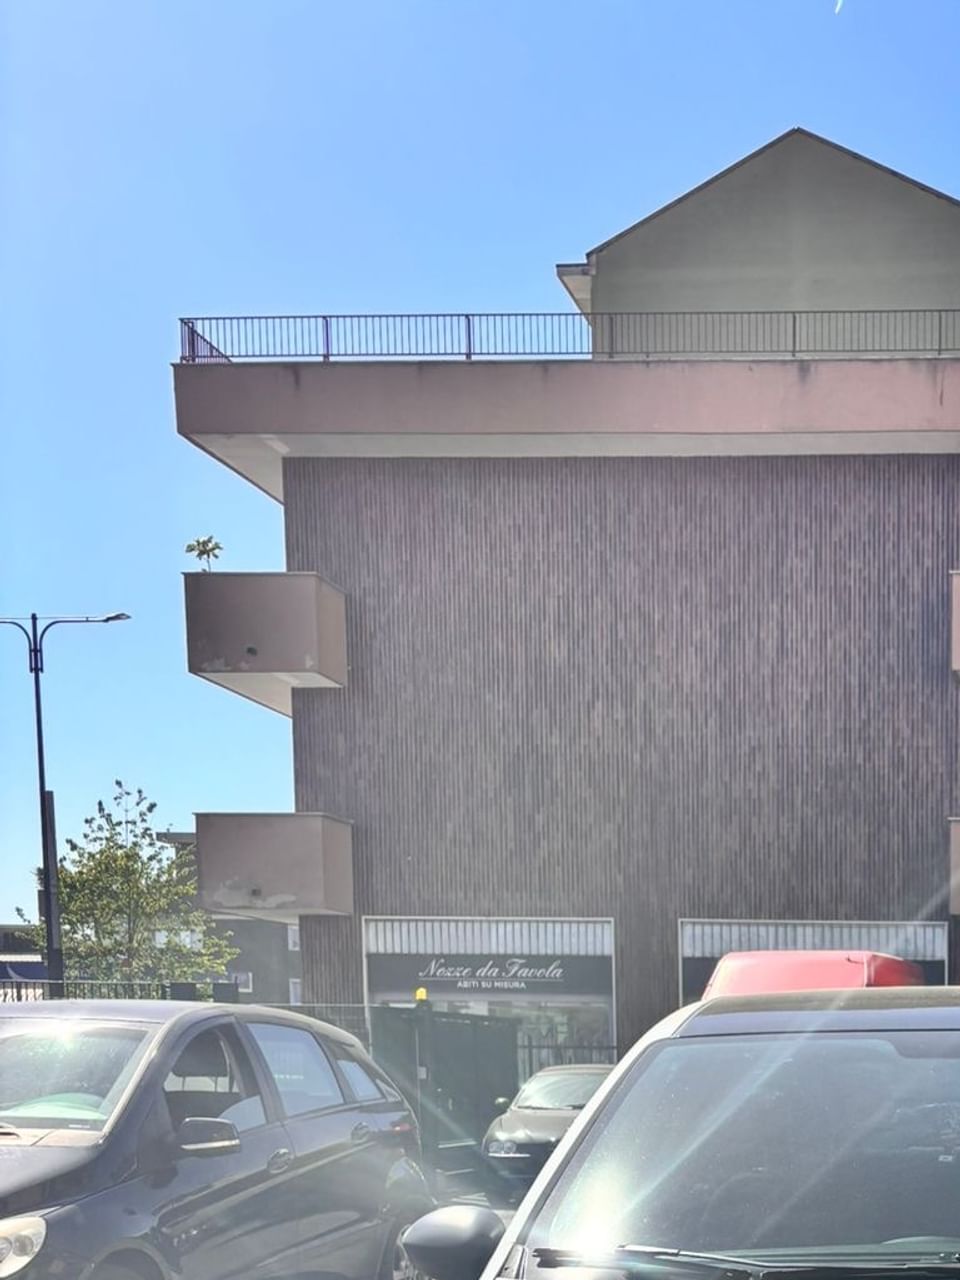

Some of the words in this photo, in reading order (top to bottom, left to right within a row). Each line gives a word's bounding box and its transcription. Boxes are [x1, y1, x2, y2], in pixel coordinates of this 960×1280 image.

[418, 958, 472, 977] Nozze
[476, 960, 499, 977] da
[502, 958, 564, 978] Favola
[457, 981, 479, 989] ABITI
[481, 981, 491, 989] SU
[494, 981, 527, 989] MISURA
